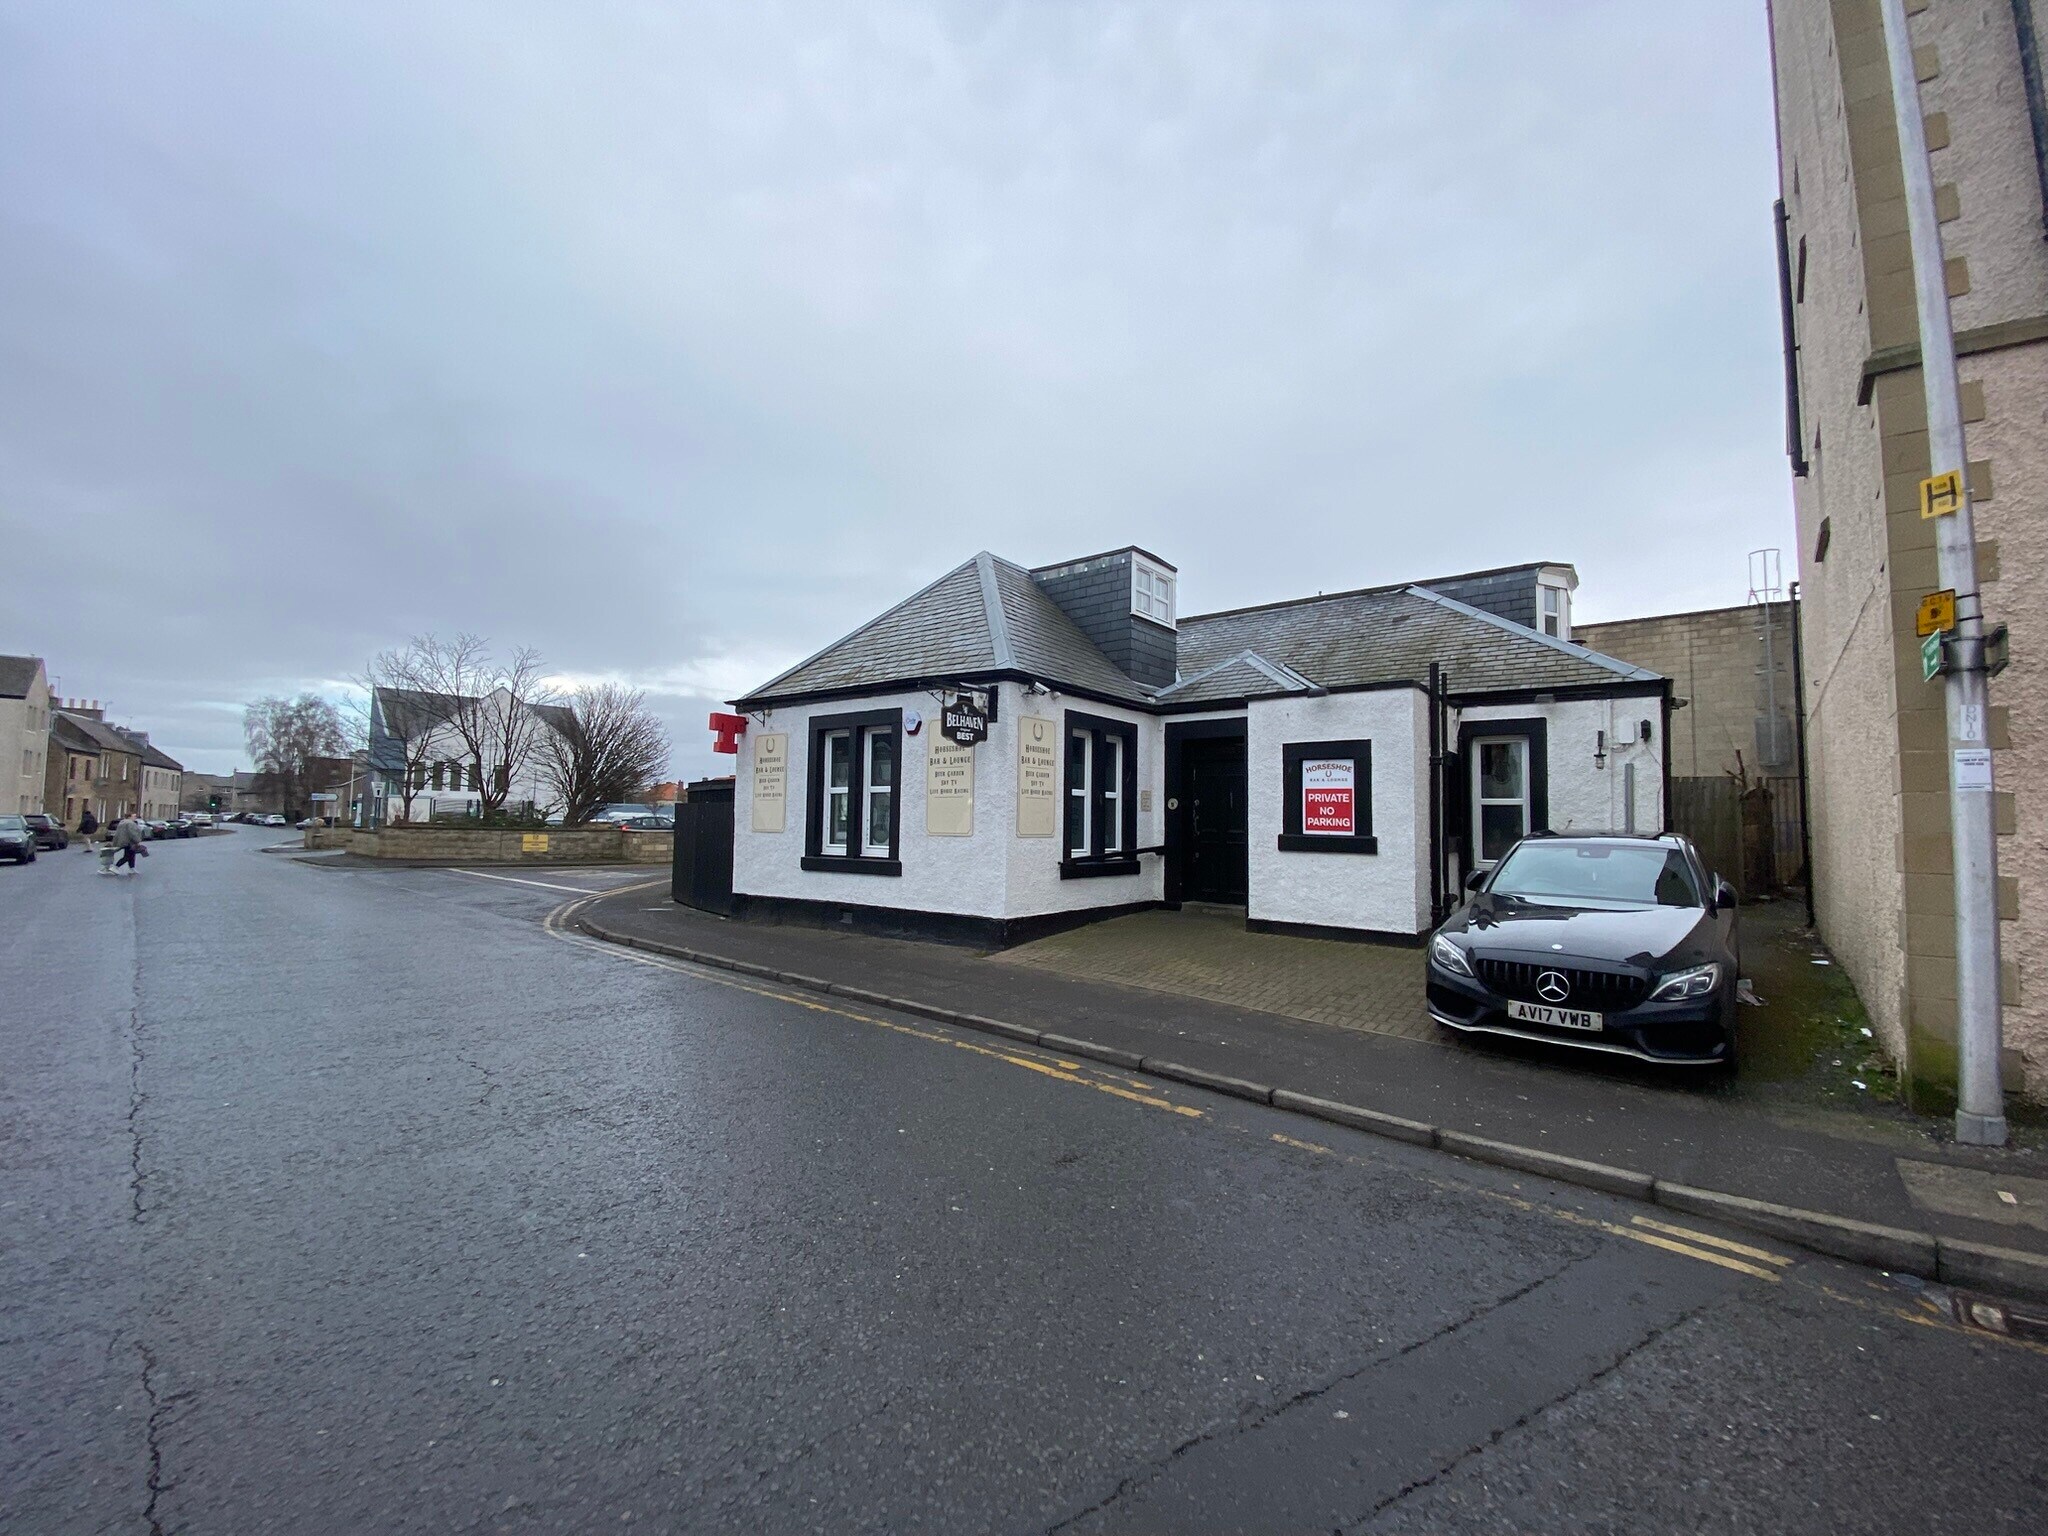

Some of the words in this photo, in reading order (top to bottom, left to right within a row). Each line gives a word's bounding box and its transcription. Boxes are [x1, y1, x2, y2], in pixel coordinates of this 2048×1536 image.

[1926, 475, 1957, 514] H
[946, 712, 984, 731] BELHAVEN
[956, 731, 975, 741] BEST
[929, 757, 940, 766] BAR
[1305, 763, 1352, 773] HORSESHOE
[1308, 793, 1350, 803] PRIVATE
[1319, 806, 1335, 816] NO
[1307, 817, 1351, 827] PARKING
[1518, 1004, 1553, 1022] AV17
[1558, 1010, 1591, 1028] VWB
